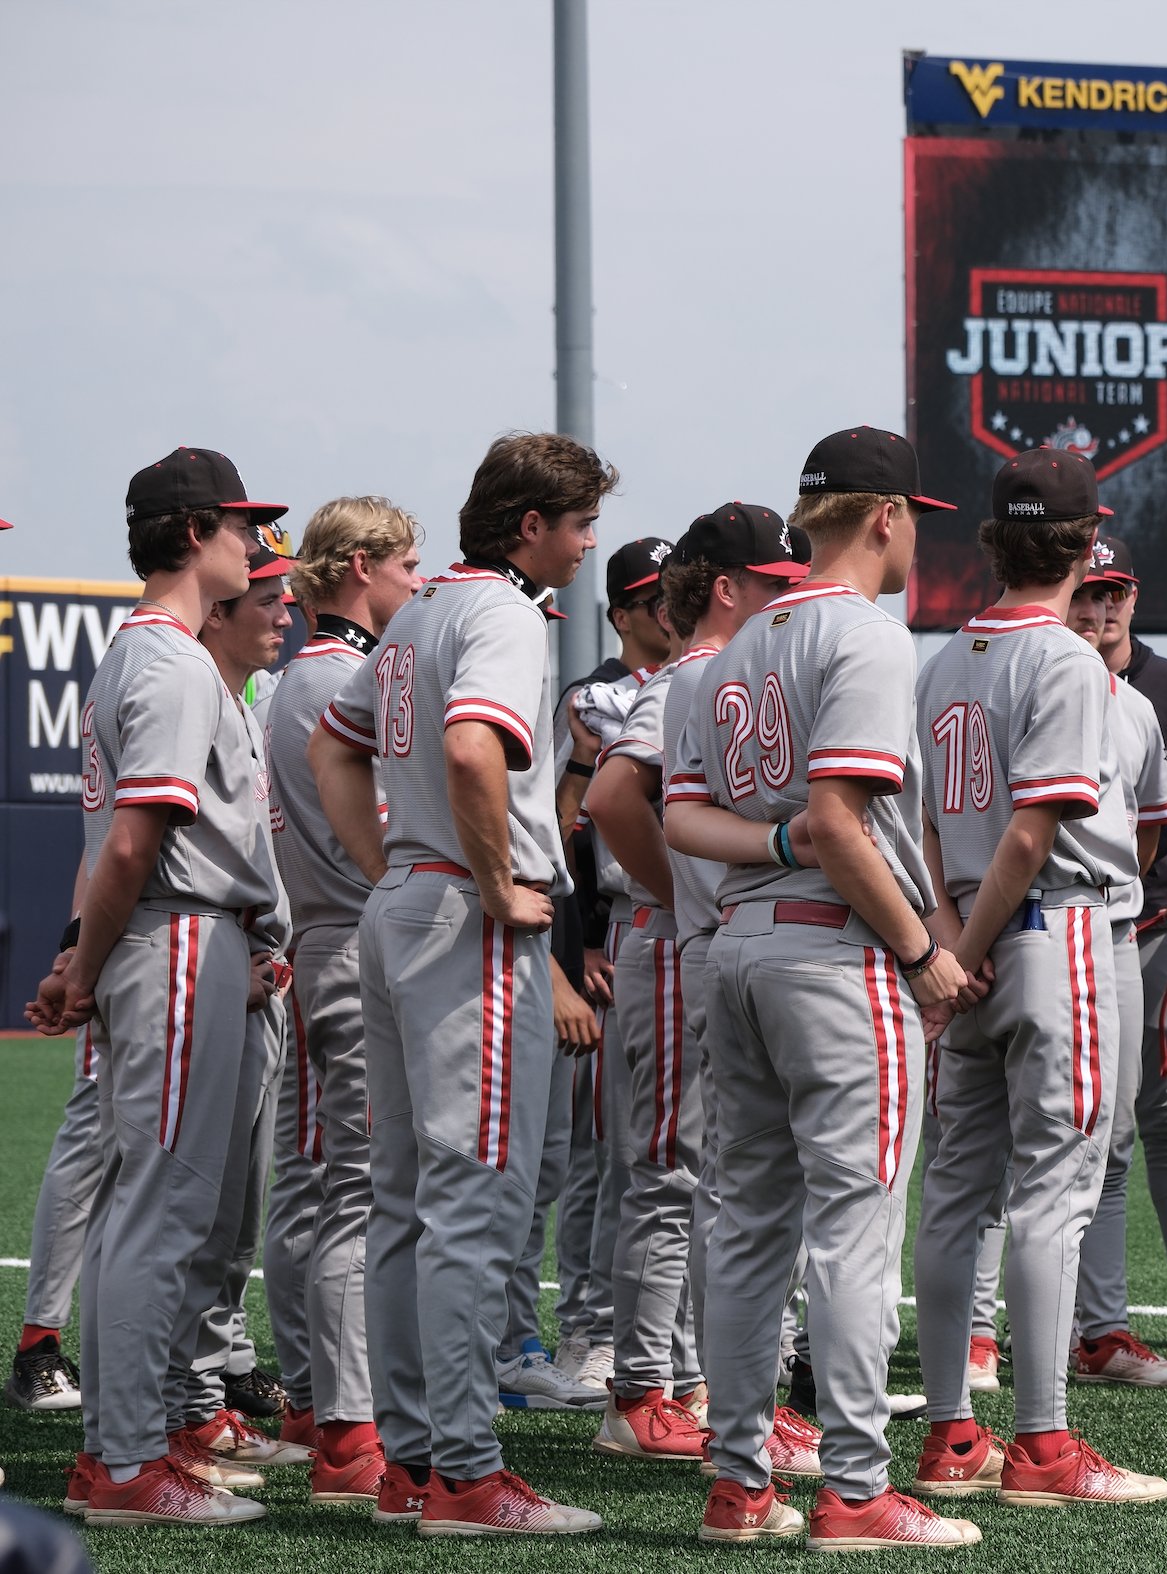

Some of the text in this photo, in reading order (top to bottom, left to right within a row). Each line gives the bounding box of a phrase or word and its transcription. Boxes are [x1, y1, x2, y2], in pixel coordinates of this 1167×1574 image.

[998, 380, 1144, 405] NATIONAL TEAM
[800, 471, 826, 483] ASEBALL
[1008, 503, 1045, 511] BASEBALL
[17, 602, 136, 671] WV
[375, 644, 415, 758] 13
[715, 672, 794, 802] 29
[932, 700, 993, 814] 19
